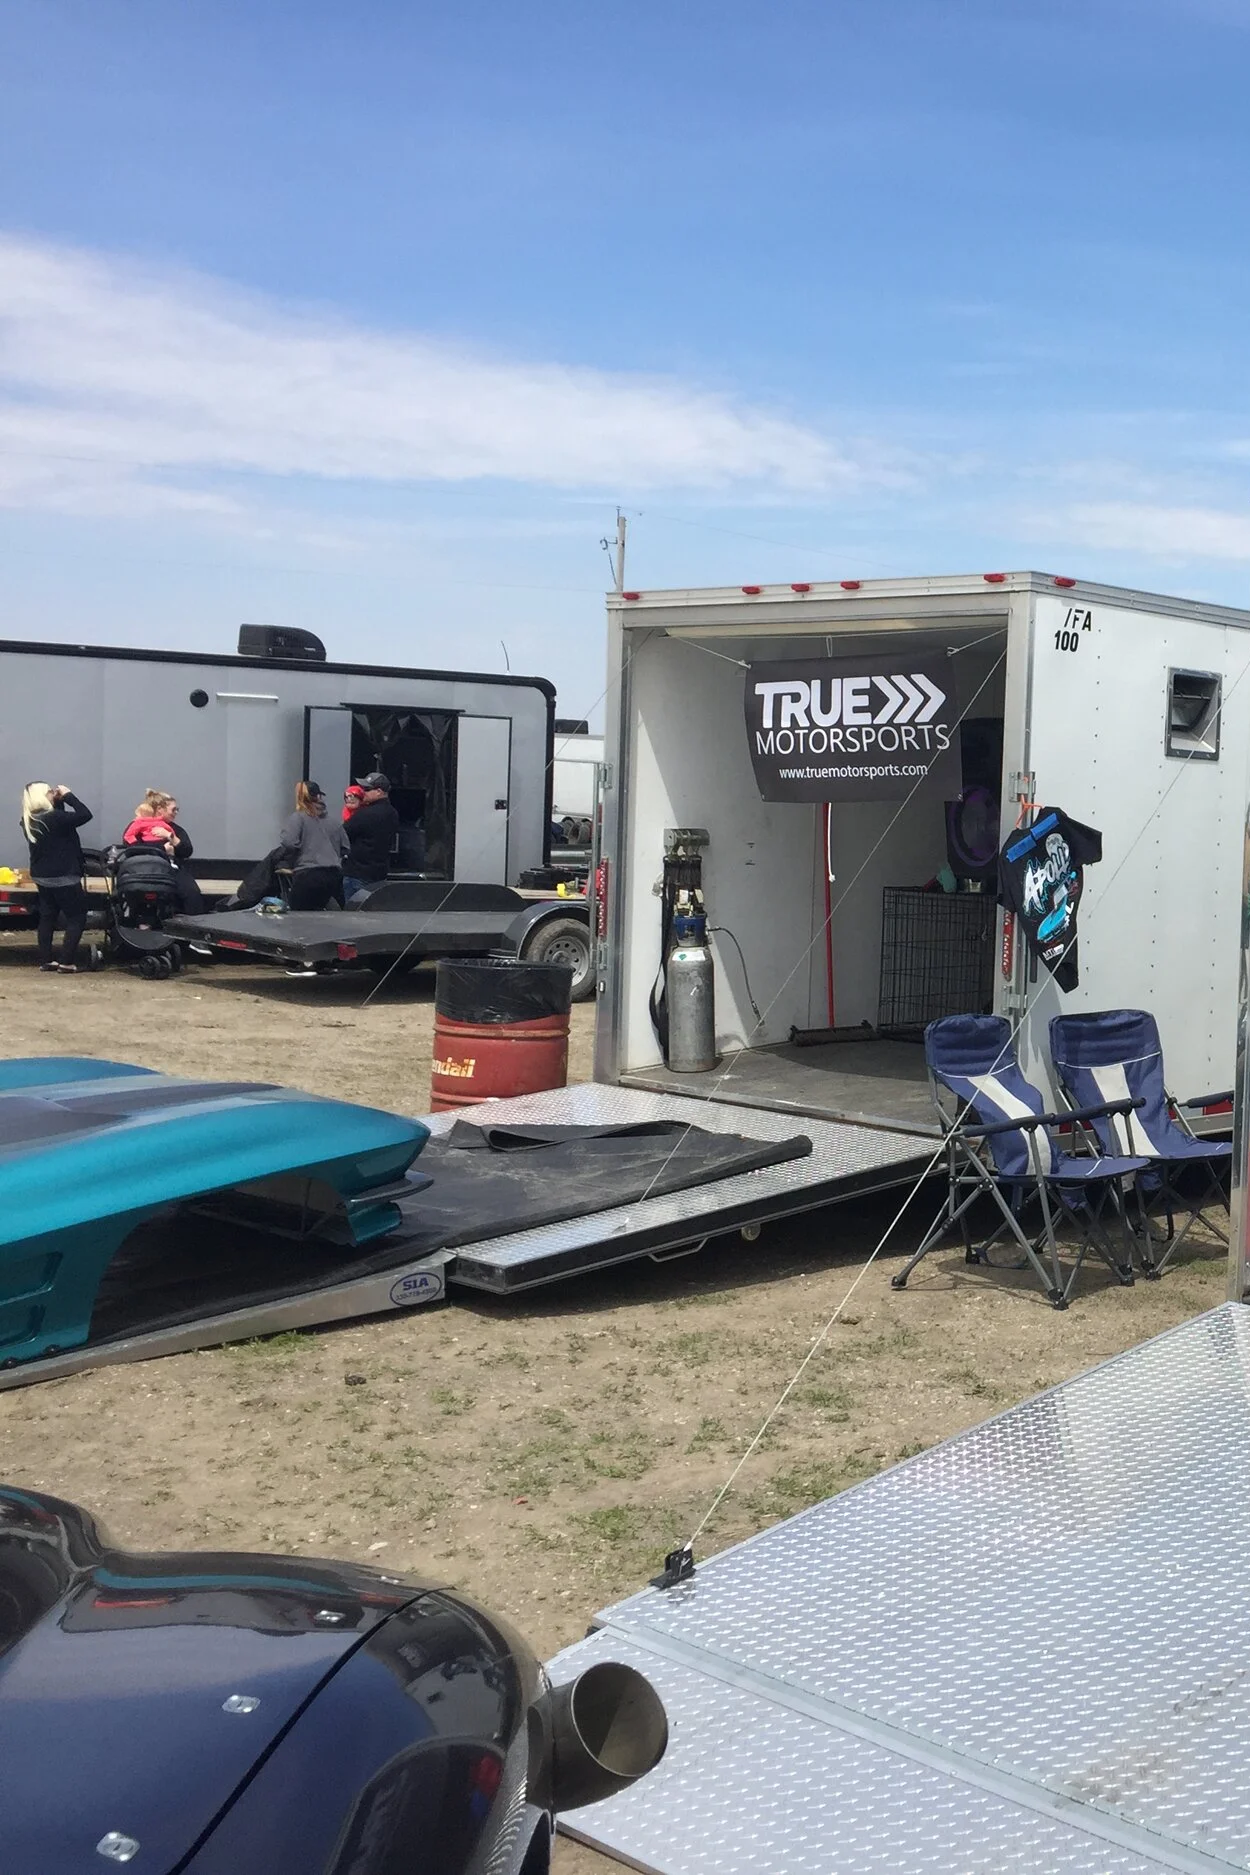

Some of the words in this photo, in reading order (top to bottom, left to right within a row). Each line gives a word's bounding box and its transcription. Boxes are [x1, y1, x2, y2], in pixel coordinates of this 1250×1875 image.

[1054, 630, 1079, 652] 100
[755, 676, 872, 729] TRUE
[755, 723, 951, 755] MOTORSPORTS
[779, 763, 929, 781] www.truemotorsports.com
[431, 1057, 476, 1078] endall
[403, 1277, 429, 1291] SIA
